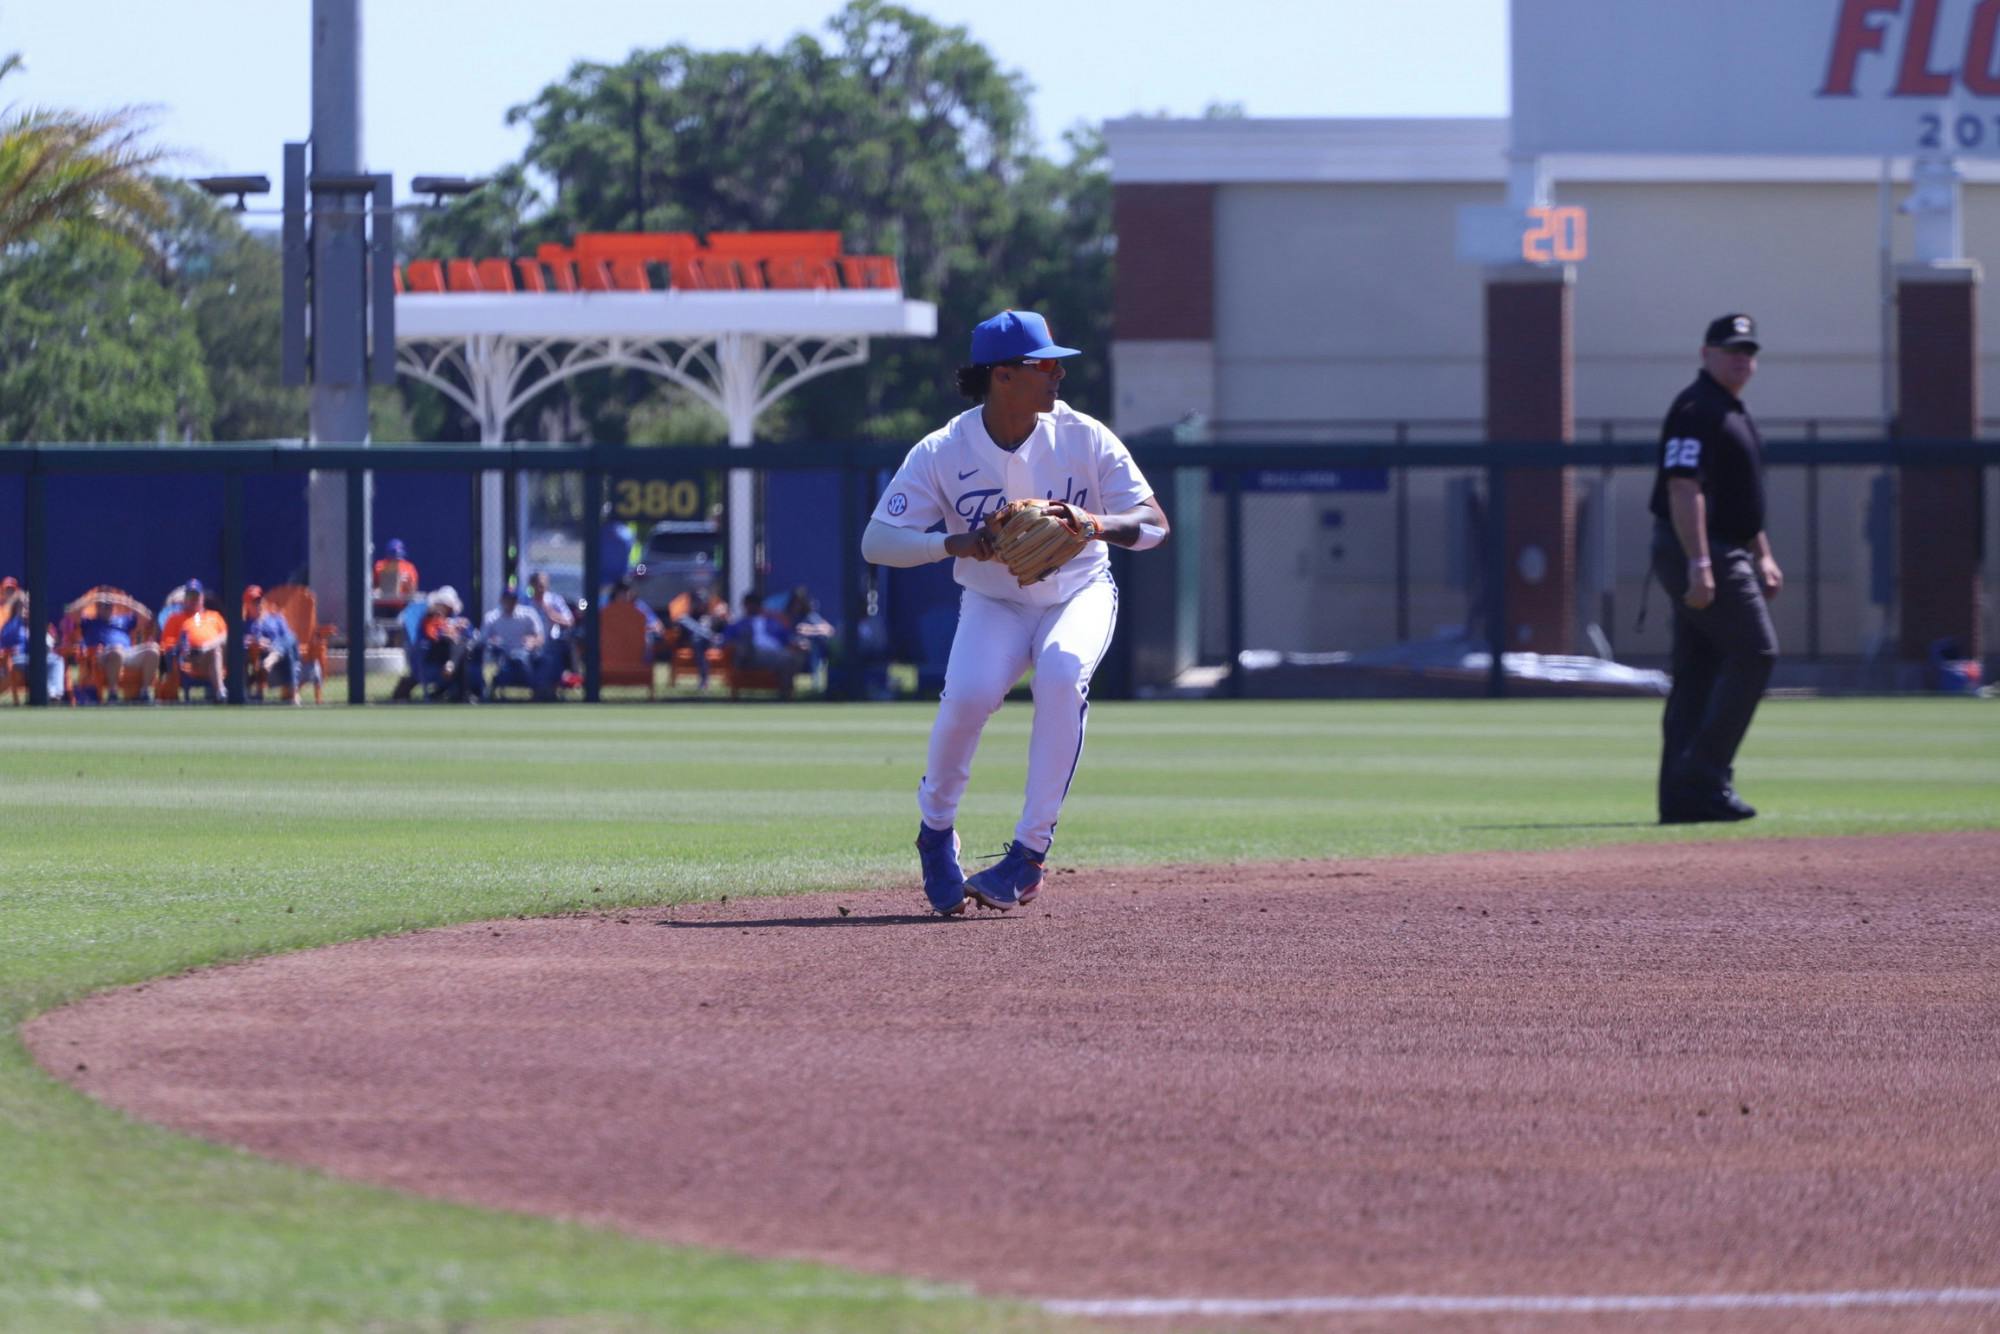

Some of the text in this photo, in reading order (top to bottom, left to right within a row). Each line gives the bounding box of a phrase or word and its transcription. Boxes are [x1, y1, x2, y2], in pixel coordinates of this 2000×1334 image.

[1522, 207, 1587, 262] 20
[1664, 437, 1701, 468] 22
[616, 480, 698, 517] 380
